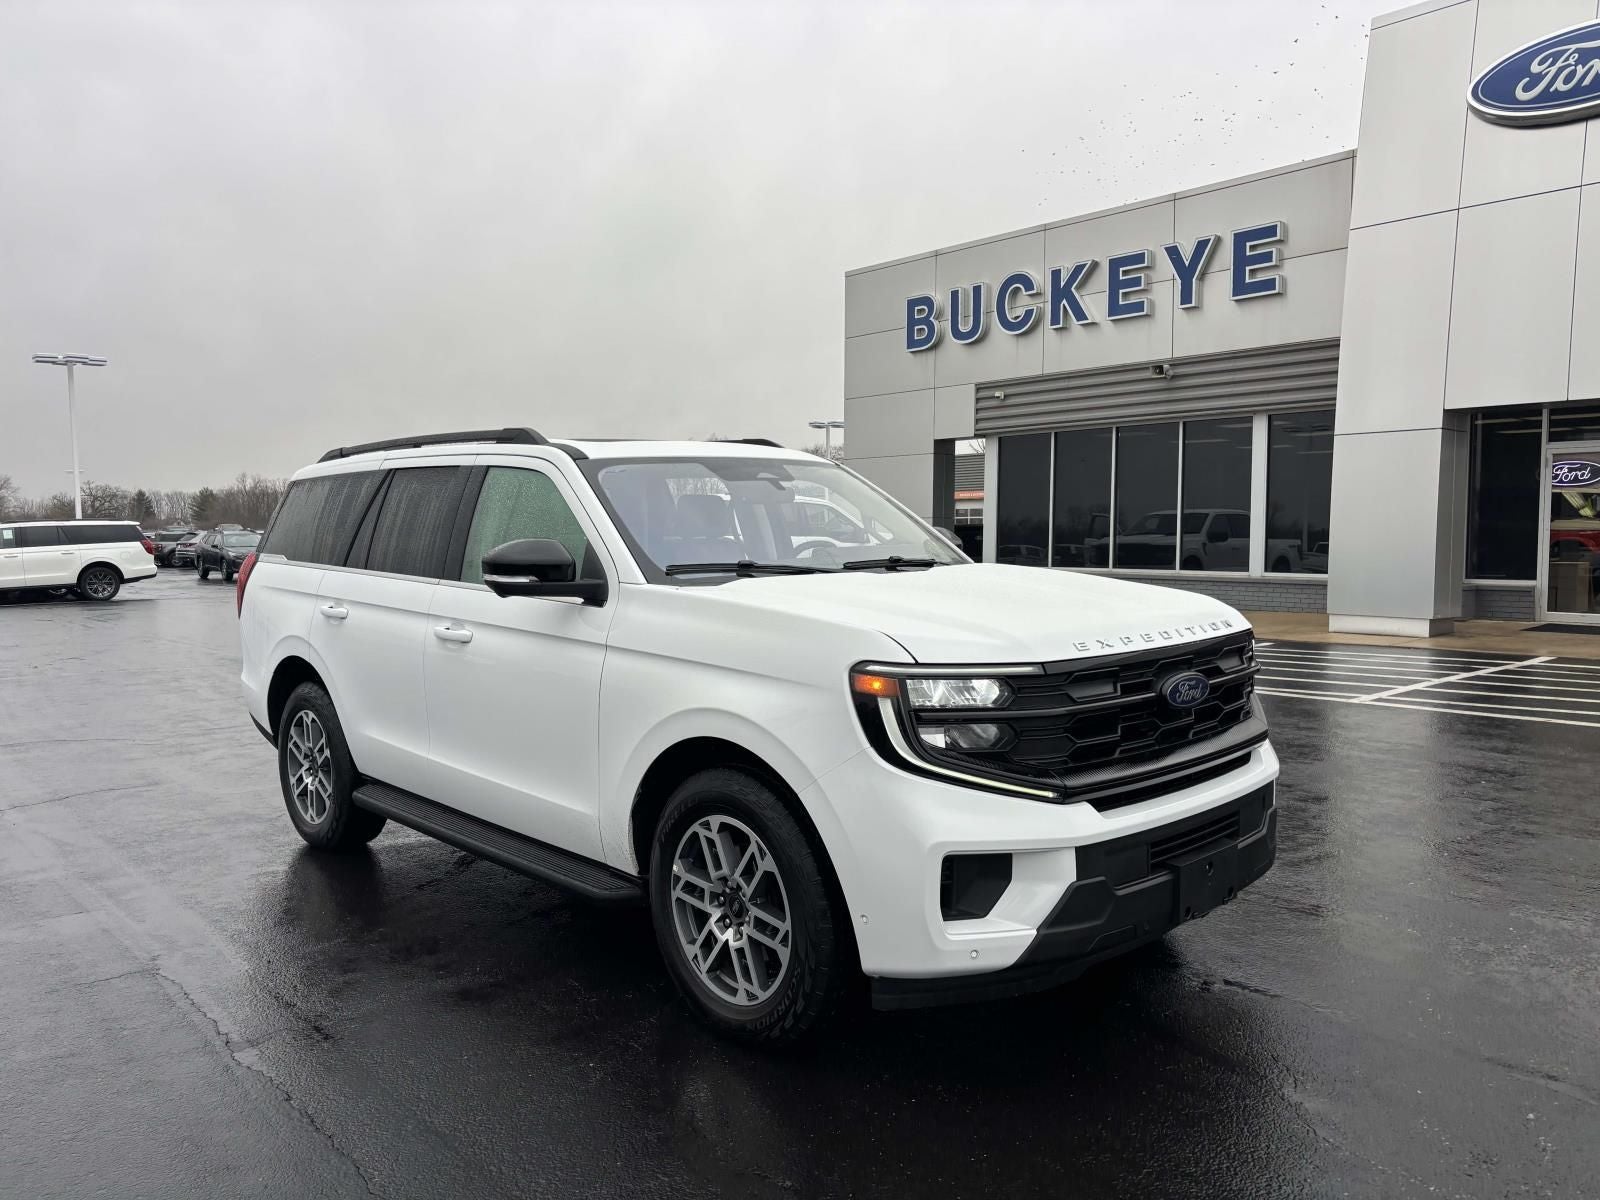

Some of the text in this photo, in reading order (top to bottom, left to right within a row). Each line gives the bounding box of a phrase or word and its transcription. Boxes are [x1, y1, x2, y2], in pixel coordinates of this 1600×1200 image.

[1515, 40, 1600, 101] For
[905, 220, 1286, 353] BUCKEYE
[1552, 464, 1591, 482] Ford
[1073, 619, 1234, 652] EXPEDITION
[1176, 680, 1203, 703] Ford
